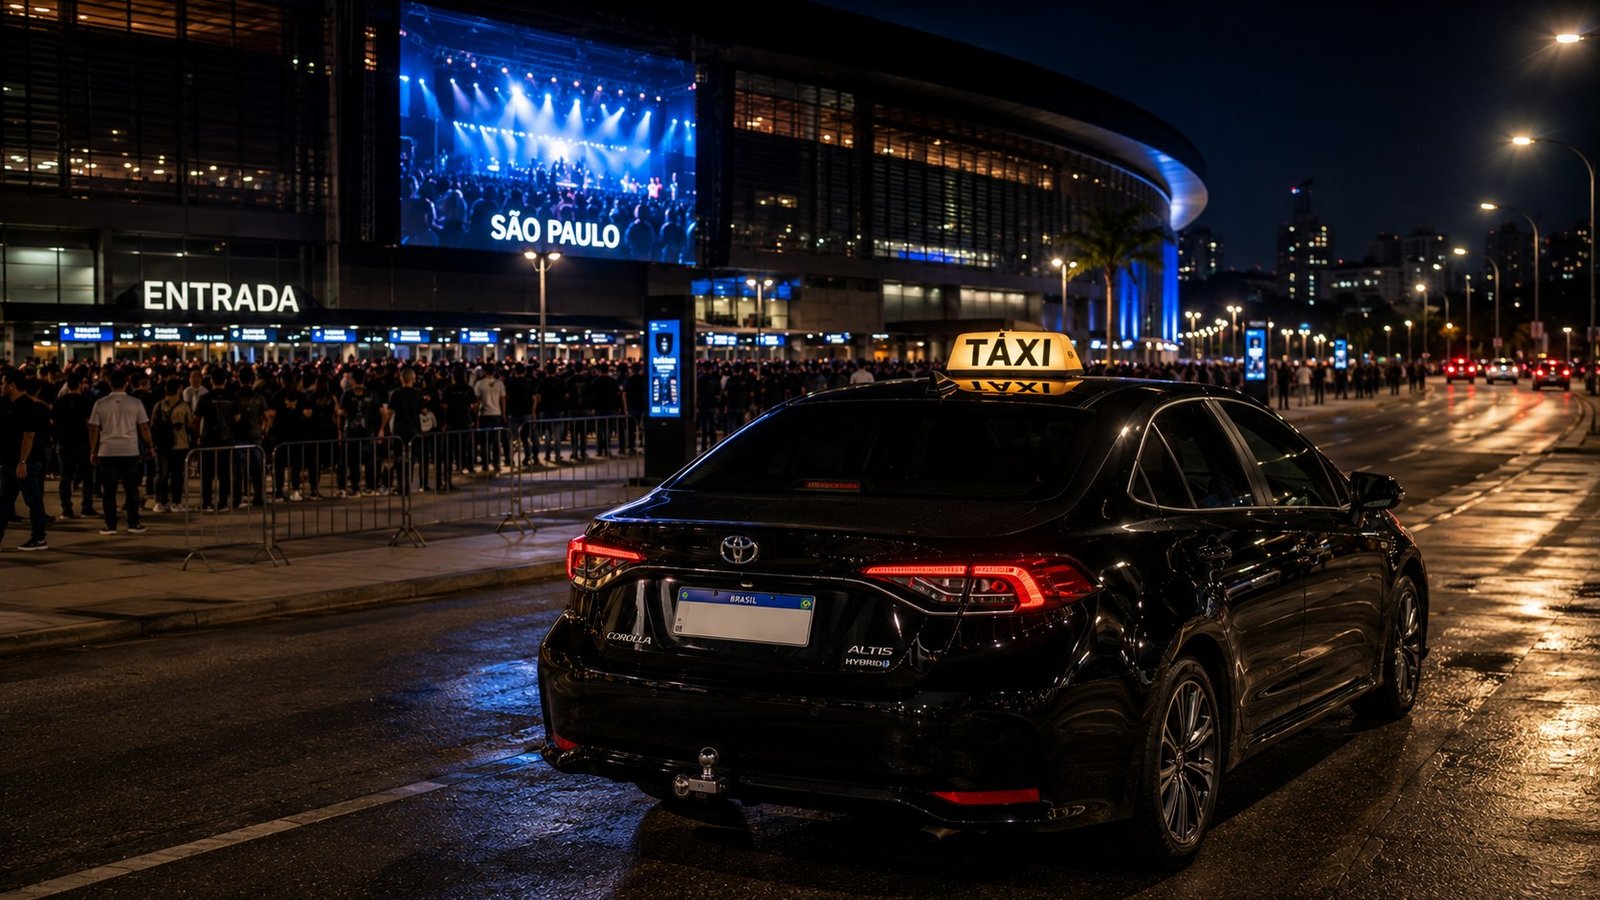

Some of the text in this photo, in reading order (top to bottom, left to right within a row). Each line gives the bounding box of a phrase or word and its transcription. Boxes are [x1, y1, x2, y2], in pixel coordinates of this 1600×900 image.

[490, 210, 620, 249] SÃO PAULO
[143, 280, 300, 313] ENTRADA
[965, 332, 1051, 367] TÁXI
[729, 594, 757, 605] BRASIL
[606, 631, 652, 645] COROLLA
[847, 645, 894, 656] ALTIS
